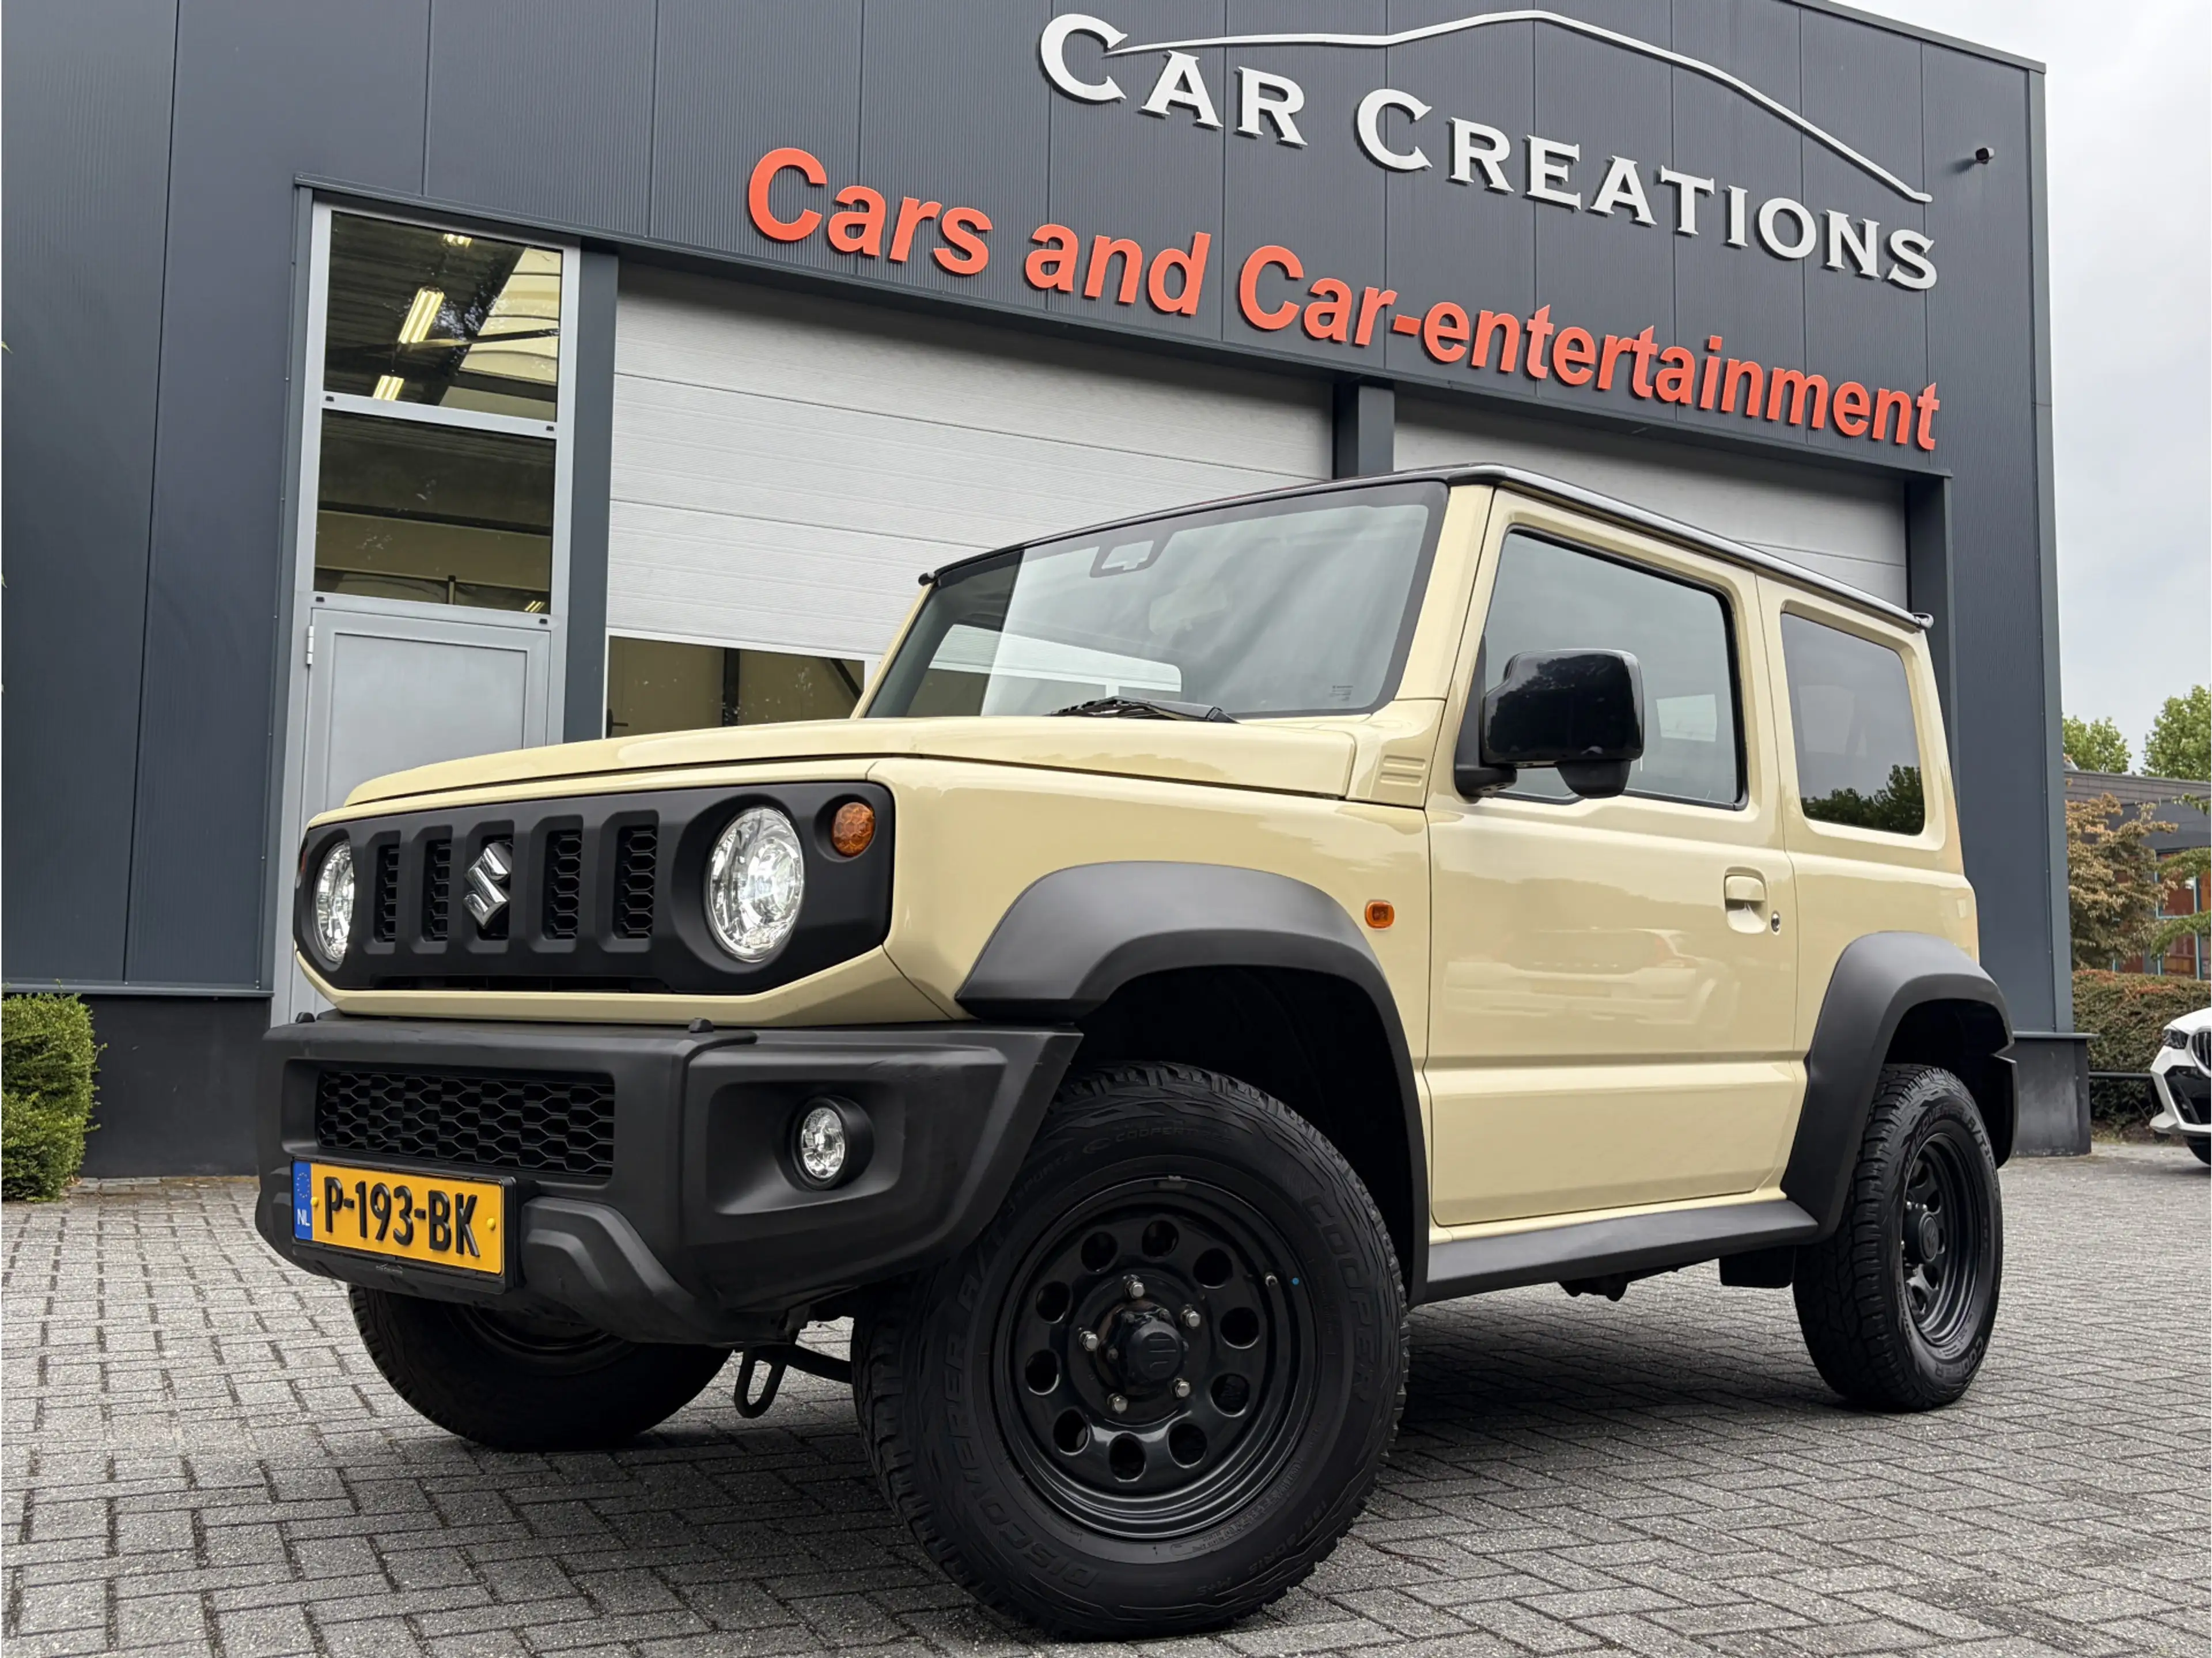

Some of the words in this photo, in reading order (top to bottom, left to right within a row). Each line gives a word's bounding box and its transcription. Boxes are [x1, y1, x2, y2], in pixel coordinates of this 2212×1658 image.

[1040, 13, 1308, 146] CAR
[1357, 88, 1938, 289] CREATIONS
[748, 147, 992, 275] Cars
[1025, 224, 1211, 315] and
[1240, 245, 1940, 451] Car-entertainment
[297, 1208, 311, 1227] NL
[324, 1176, 480, 1258] P-193-BK
